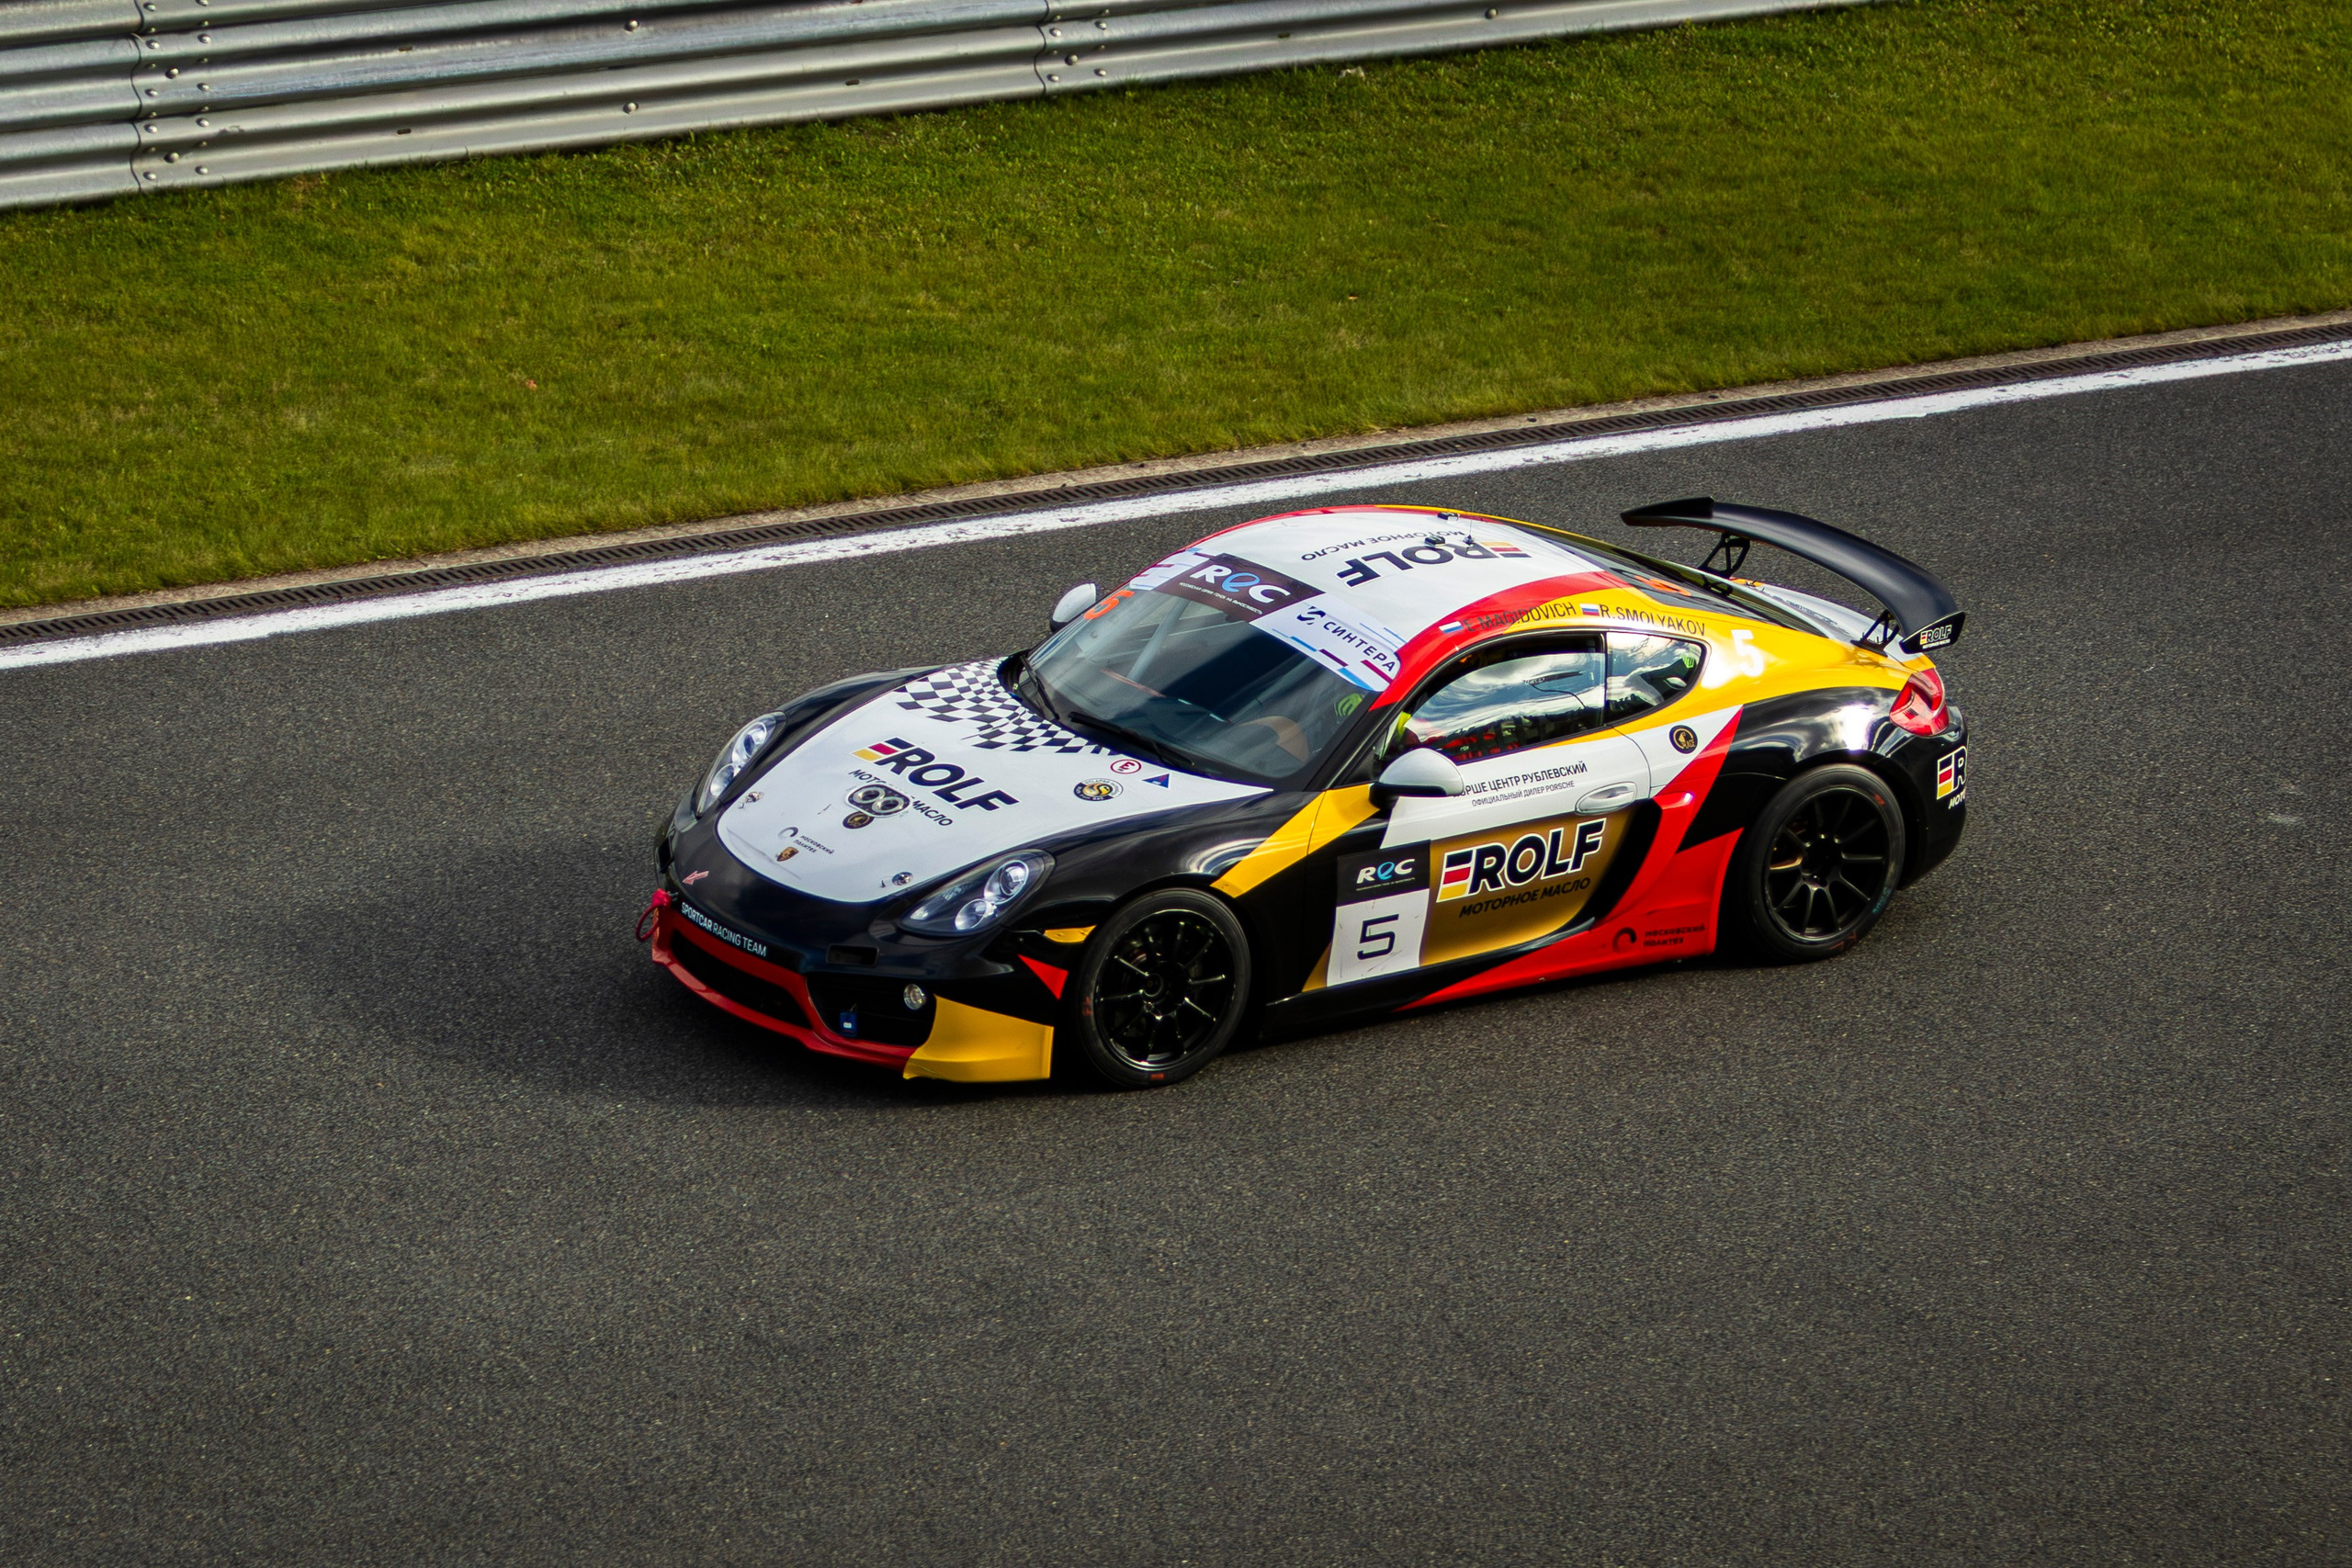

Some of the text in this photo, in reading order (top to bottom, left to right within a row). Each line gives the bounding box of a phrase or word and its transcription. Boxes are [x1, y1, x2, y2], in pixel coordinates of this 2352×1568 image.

[1302, 541, 1365, 561] МАСЛО
[1336, 542, 1499, 588] ROLF
[1083, 590, 1135, 620] 5
[1322, 621, 1396, 671] СИНТЕРА
[1730, 629, 1765, 677] 5
[1926, 625, 1952, 643] ROLF
[874, 747, 1021, 812] ROLF
[1471, 780, 1576, 807] ОФИЦИАЛЬНЫЙ ДИЛЕР PORSCHE
[1488, 775, 1521, 792] ЦЕНТР
[1521, 761, 1589, 784] РУБЛЕВСКИЙ
[912, 800, 953, 826] МАСЛО
[1467, 818, 1607, 896] ROLF
[1458, 877, 1591, 919] МОТОРНОЕ МАСЛО
[682, 902, 767, 956] SPORTCAR RACING TEAM
[1357, 913, 1399, 960] 5
